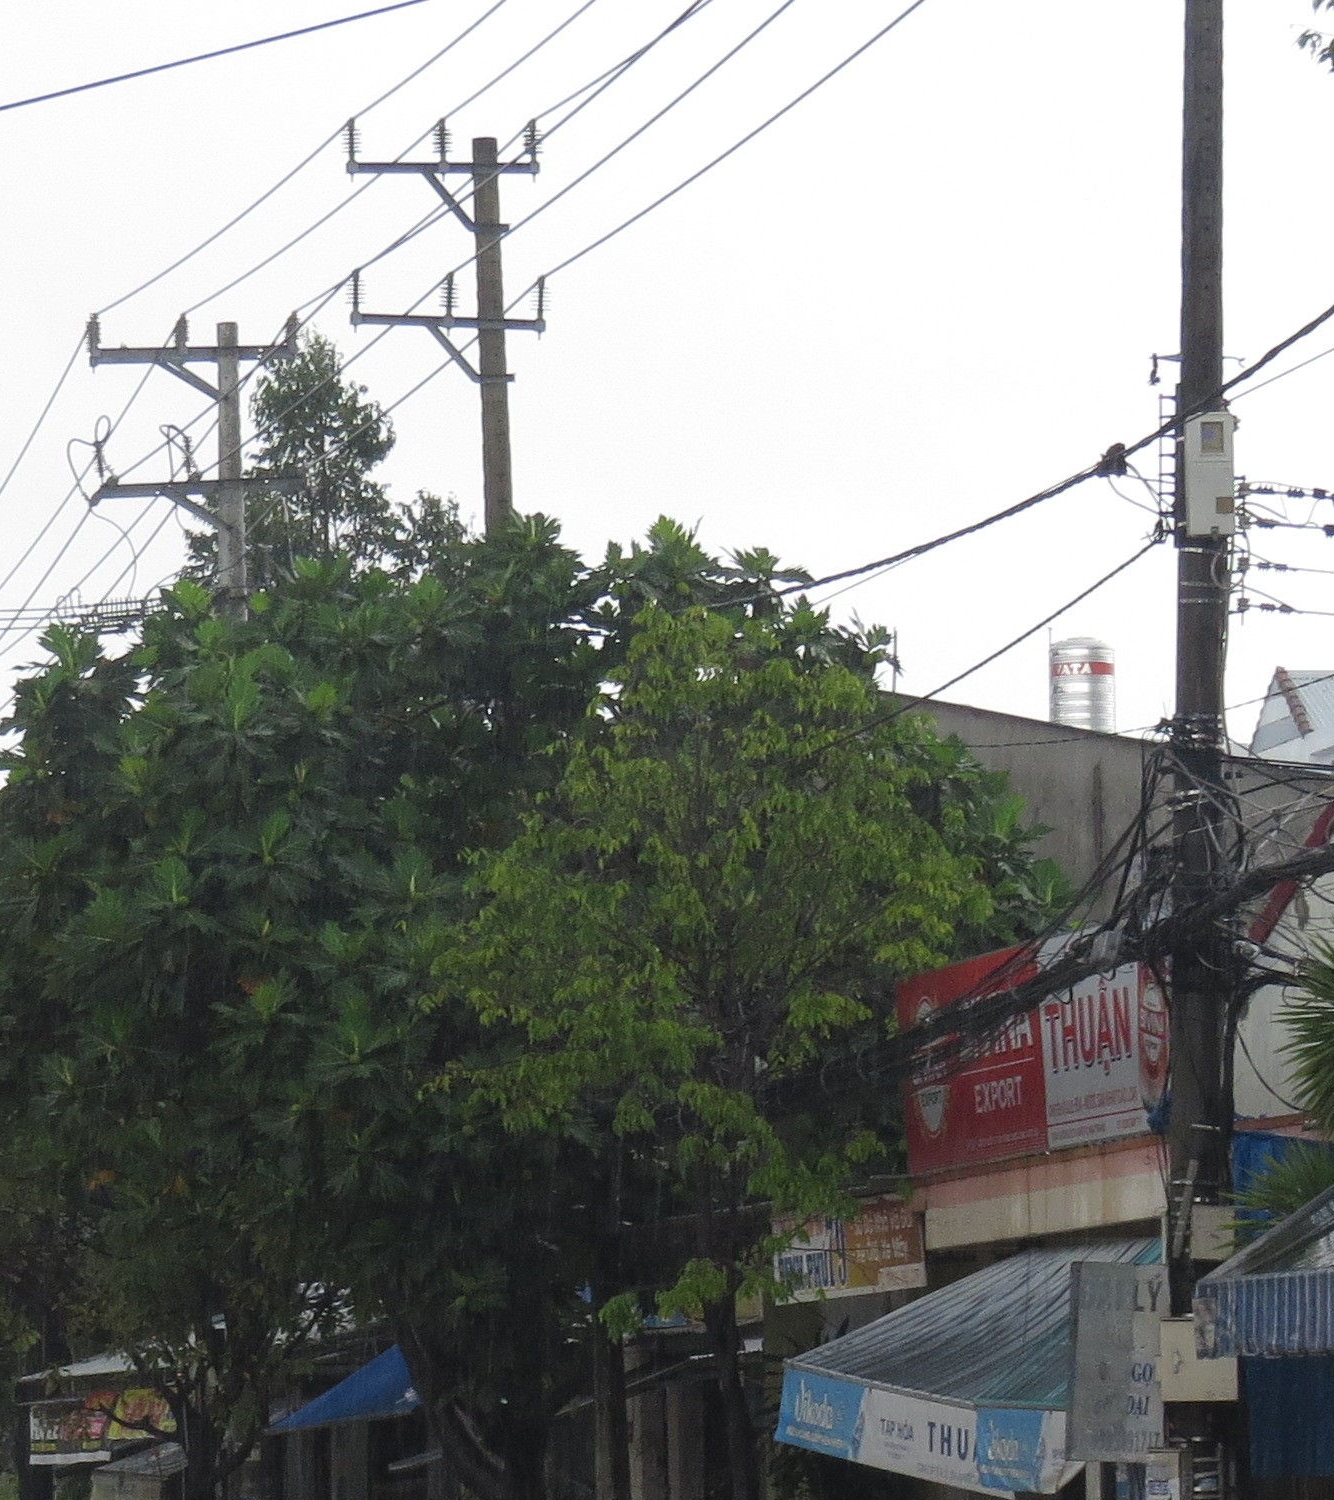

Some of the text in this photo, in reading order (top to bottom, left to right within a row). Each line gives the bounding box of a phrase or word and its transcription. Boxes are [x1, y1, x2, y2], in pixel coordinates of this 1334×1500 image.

[1057, 662, 1092, 675] ATA
[1045, 979, 1133, 1076] THUẬN
[973, 1075, 1023, 1114] EXPORT
[927, 1421, 976, 1463] THU
